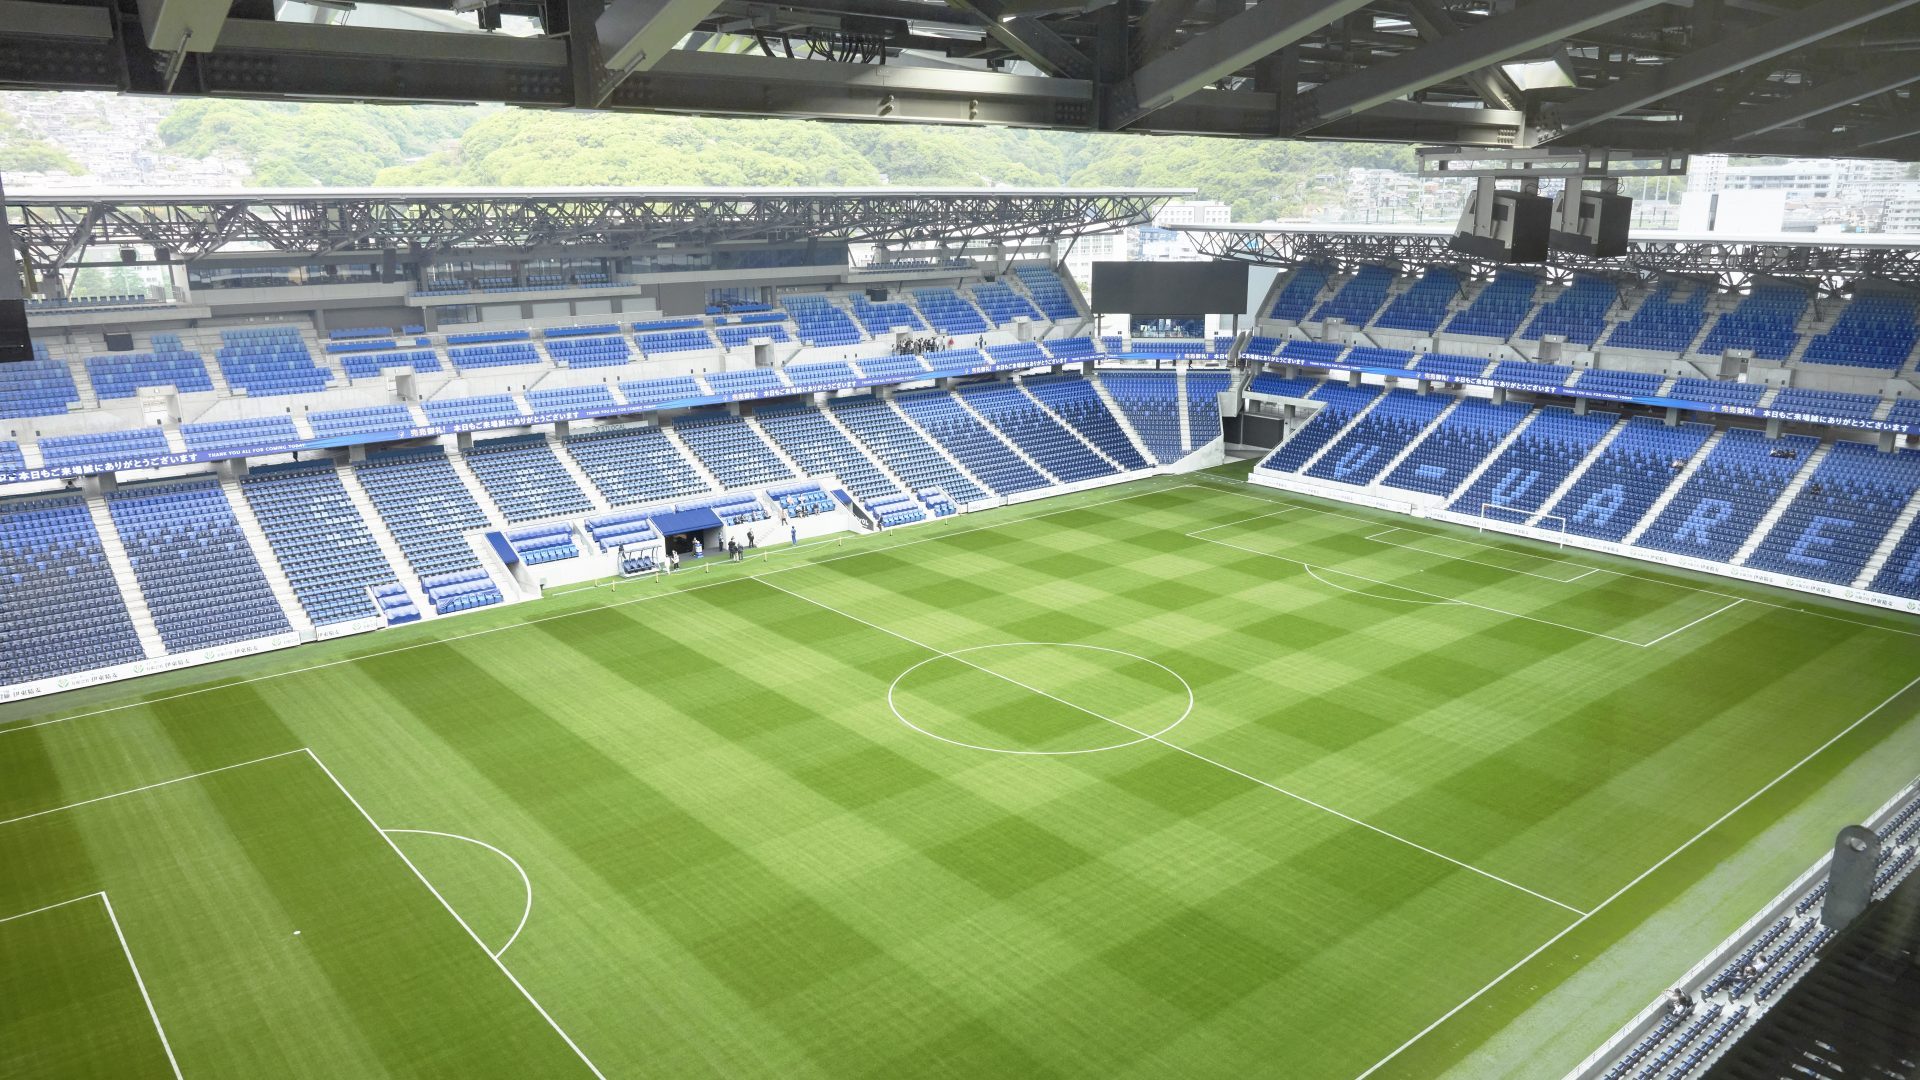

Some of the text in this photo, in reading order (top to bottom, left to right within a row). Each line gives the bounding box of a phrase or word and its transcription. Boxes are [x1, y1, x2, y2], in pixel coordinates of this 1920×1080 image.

[453, 412, 579, 432] 本日もご来場誠にありがとうございます
[1763, 409, 1910, 432] 本日もご来場誠にありがとうございます
[18, 453, 198, 481] 本日もご来場誠にありがとうございます
[208, 450, 228, 458] THANK
